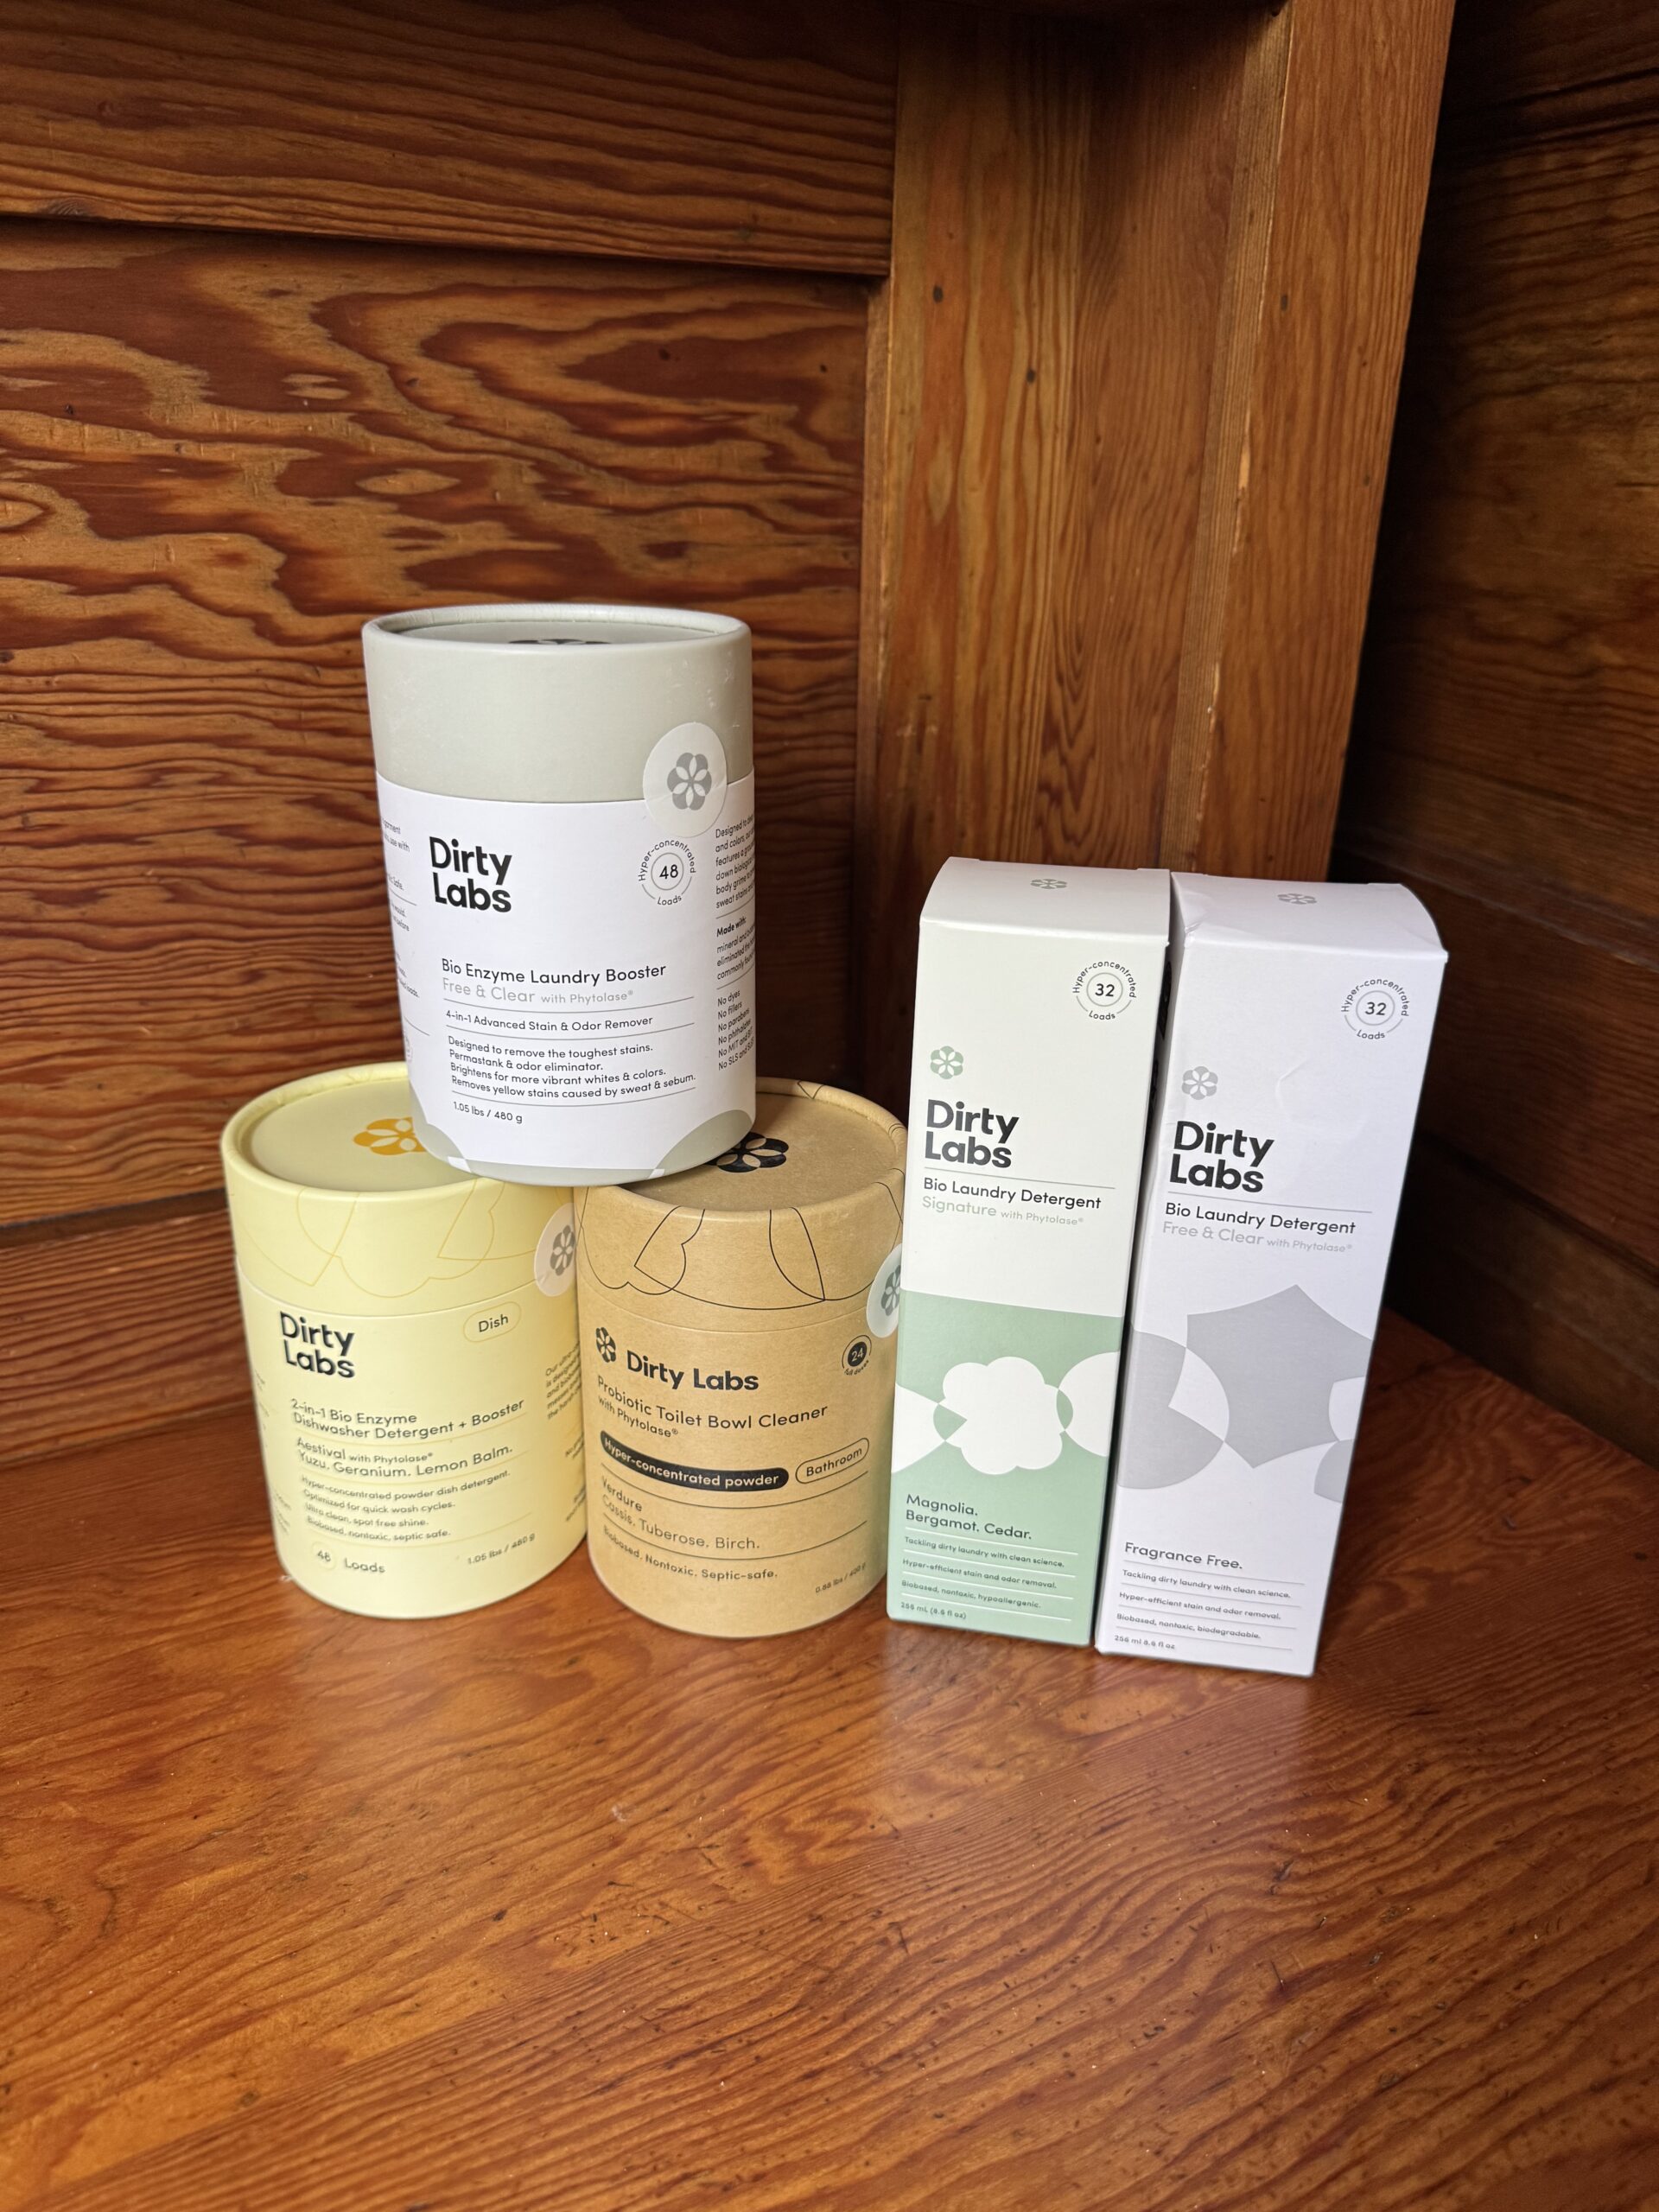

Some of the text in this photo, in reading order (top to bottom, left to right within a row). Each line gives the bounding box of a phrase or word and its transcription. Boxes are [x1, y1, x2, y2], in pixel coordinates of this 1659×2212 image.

[429, 836, 512, 886] Dirty
[638, 840, 696, 881] Hyper-concentrated
[659, 864, 678, 879] 48
[433, 872, 512, 912] Labs
[658, 895, 682, 906] Loads
[442, 958, 666, 987] Bio Enzyme Laundry Booster
[1072, 961, 1136, 998] Hyper-concentrated
[442, 977, 471, 995] Free
[476, 985, 486, 998] &
[491, 987, 535, 1002] Clear
[541, 995, 565, 1003] with
[1095, 983, 1115, 997] 32
[1341, 979, 1409, 1016] Hyper-concentrated
[446, 1010, 653, 1031] 4-in-1 Advanced Stain & Odor Remover
[1089, 1010, 1116, 1020] Loads
[1365, 1001, 1386, 1015] 32
[448, 1035, 652, 1059] Designed to remove the toughest stains.
[1357, 1029, 1385, 1039] Loads
[449, 1049, 503, 1068] Permastank
[517, 1061, 541, 1070] odor
[544, 1062, 603, 1071] eliminator.
[451, 1062, 492, 1078] Brightens
[494, 1071, 508, 1081] for
[542, 1076, 582, 1085] vibrant
[585, 1075, 620, 1084] whites
[633, 1069, 666, 1080] colors.
[452, 1076, 490, 1092] Removes
[493, 1086, 524, 1095] yellow
[563, 1088, 601, 1097] caused
[605, 1088, 618, 1097] by
[621, 1084, 652, 1095] sweat
[664, 1074, 696, 1088] sebum.
[454, 1102, 522, 1124] 1.05 lbs 480 g
[927, 1099, 1020, 1144] Dirty
[925, 1131, 1012, 1168] Labs
[1174, 1121, 1274, 1167] Dirty
[1170, 1154, 1263, 1192] Labs
[925, 1177, 1101, 1210] Bio Laundry Detergent
[922, 1196, 996, 1216] Signature
[1001, 1211, 1022, 1219] with
[1166, 1202, 1356, 1235] Bio Laundry Detergent
[1163, 1221, 1198, 1236] Free
[1202, 1226, 1213, 1239] &
[1218, 1229, 1264, 1244] Clear
[1267, 1239, 1290, 1248] with
[280, 1311, 355, 1357] Dirty
[479, 1314, 508, 1332] Dish
[283, 1339, 355, 1378] Labs
[852, 1347, 863, 1362] 24
[627, 1350, 759, 1390] Dirty Labs
[292, 1398, 416, 1427] 2-in-1 Bio Enzyme
[598, 1375, 828, 1428] Probiotic Toilet Bowl Cleaner
[599, 1395, 614, 1414] with
[294, 1400, 524, 1440] Dishwasher Detergent Booster
[297, 1438, 346, 1459] Aestival
[349, 1454, 371, 1463] with
[298, 1446, 512, 1477] Yuzu. Geranium. Lemon Balm.
[605, 1438, 720, 1486] Hyper-concentrated
[725, 1475, 779, 1489] powder
[806, 1448, 862, 1477] Bathroom
[395, 1491, 433, 1500] powder
[437, 1486, 458, 1496] dish
[461, 1470, 510, 1491] detergent.
[602, 1475, 642, 1511] Verdure
[346, 1502, 359, 1510] for
[421, 1502, 455, 1513] cycles.
[906, 1494, 978, 1516] Magnolia.
[353, 1519, 372, 1528] spot
[602, 1493, 636, 1527] Cassis.
[639, 1518, 709, 1548] Tuberose.
[715, 1537, 760, 1549] Birch.
[906, 1510, 1032, 1539] Bergamot. Cedar.
[394, 1529, 451, 1541] septic safe.
[906, 1536, 936, 1548] Tackling
[938, 1542, 956, 1552] dirty
[958, 1547, 988, 1557] laundry
[1033, 1558, 1064, 1567] science.
[1125, 1542, 1243, 1569] Fragrance Free.
[345, 1558, 385, 1573] Loads
[645, 1554, 778, 1581] Nontoxic. Septic-safe.
[903, 1559, 962, 1574] Hyper-efficient
[963, 1569, 982, 1578] stain
[1022, 1580, 1057, 1589] removal.
[1122, 1569, 1156, 1582] Tackling
[1159, 1576, 1177, 1585] dirty
[1180, 1579, 1211, 1590] laundry
[978, 1594, 1040, 1608] hypoallergenic.
[1120, 1592, 1182, 1607] Hyper-efficient
[1244, 1611, 1281, 1619] removal.
[1198, 1625, 1261, 1638] biodegradable.
